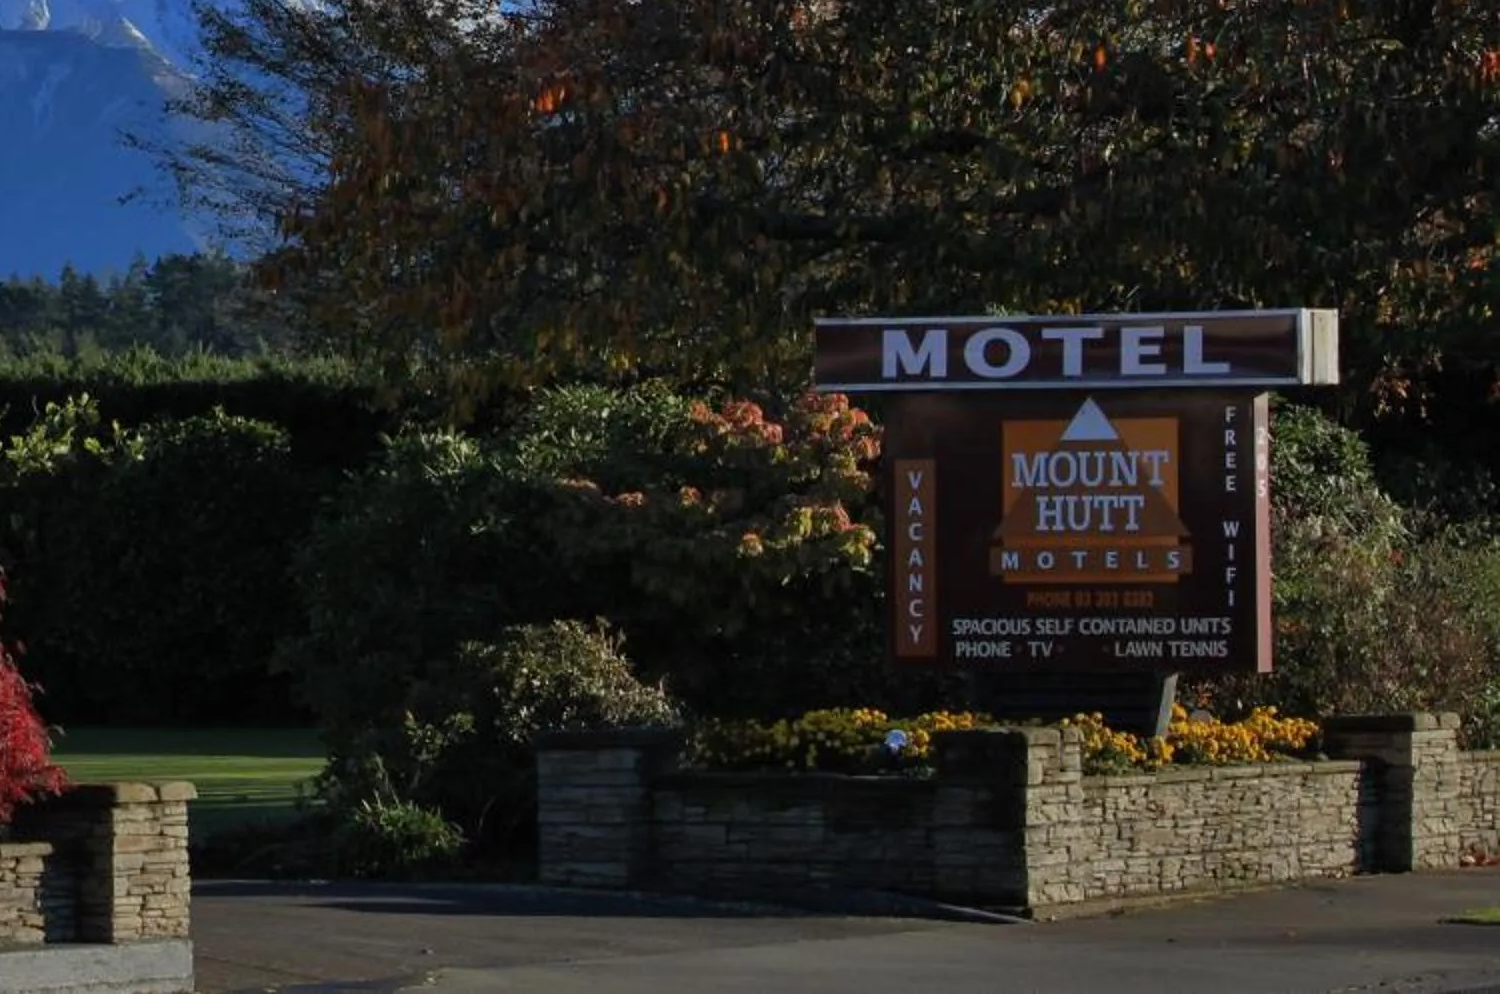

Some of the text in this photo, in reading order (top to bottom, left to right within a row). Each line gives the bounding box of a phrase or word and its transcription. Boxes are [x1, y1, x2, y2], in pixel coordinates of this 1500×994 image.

[881, 325, 1231, 379] MOTEL
[1011, 450, 1170, 489] MOUNT
[1035, 494, 1145, 532] HUTT
[1223, 406, 1240, 607] FREE WIFI
[907, 470, 923, 645] VACANCY
[1000, 550, 1182, 571] MOTELS
[952, 617, 1232, 636] SPACIOUS SELF CONTAINED UNITS
[955, 639, 1229, 658] PHONE TV LAWN TENNIS
